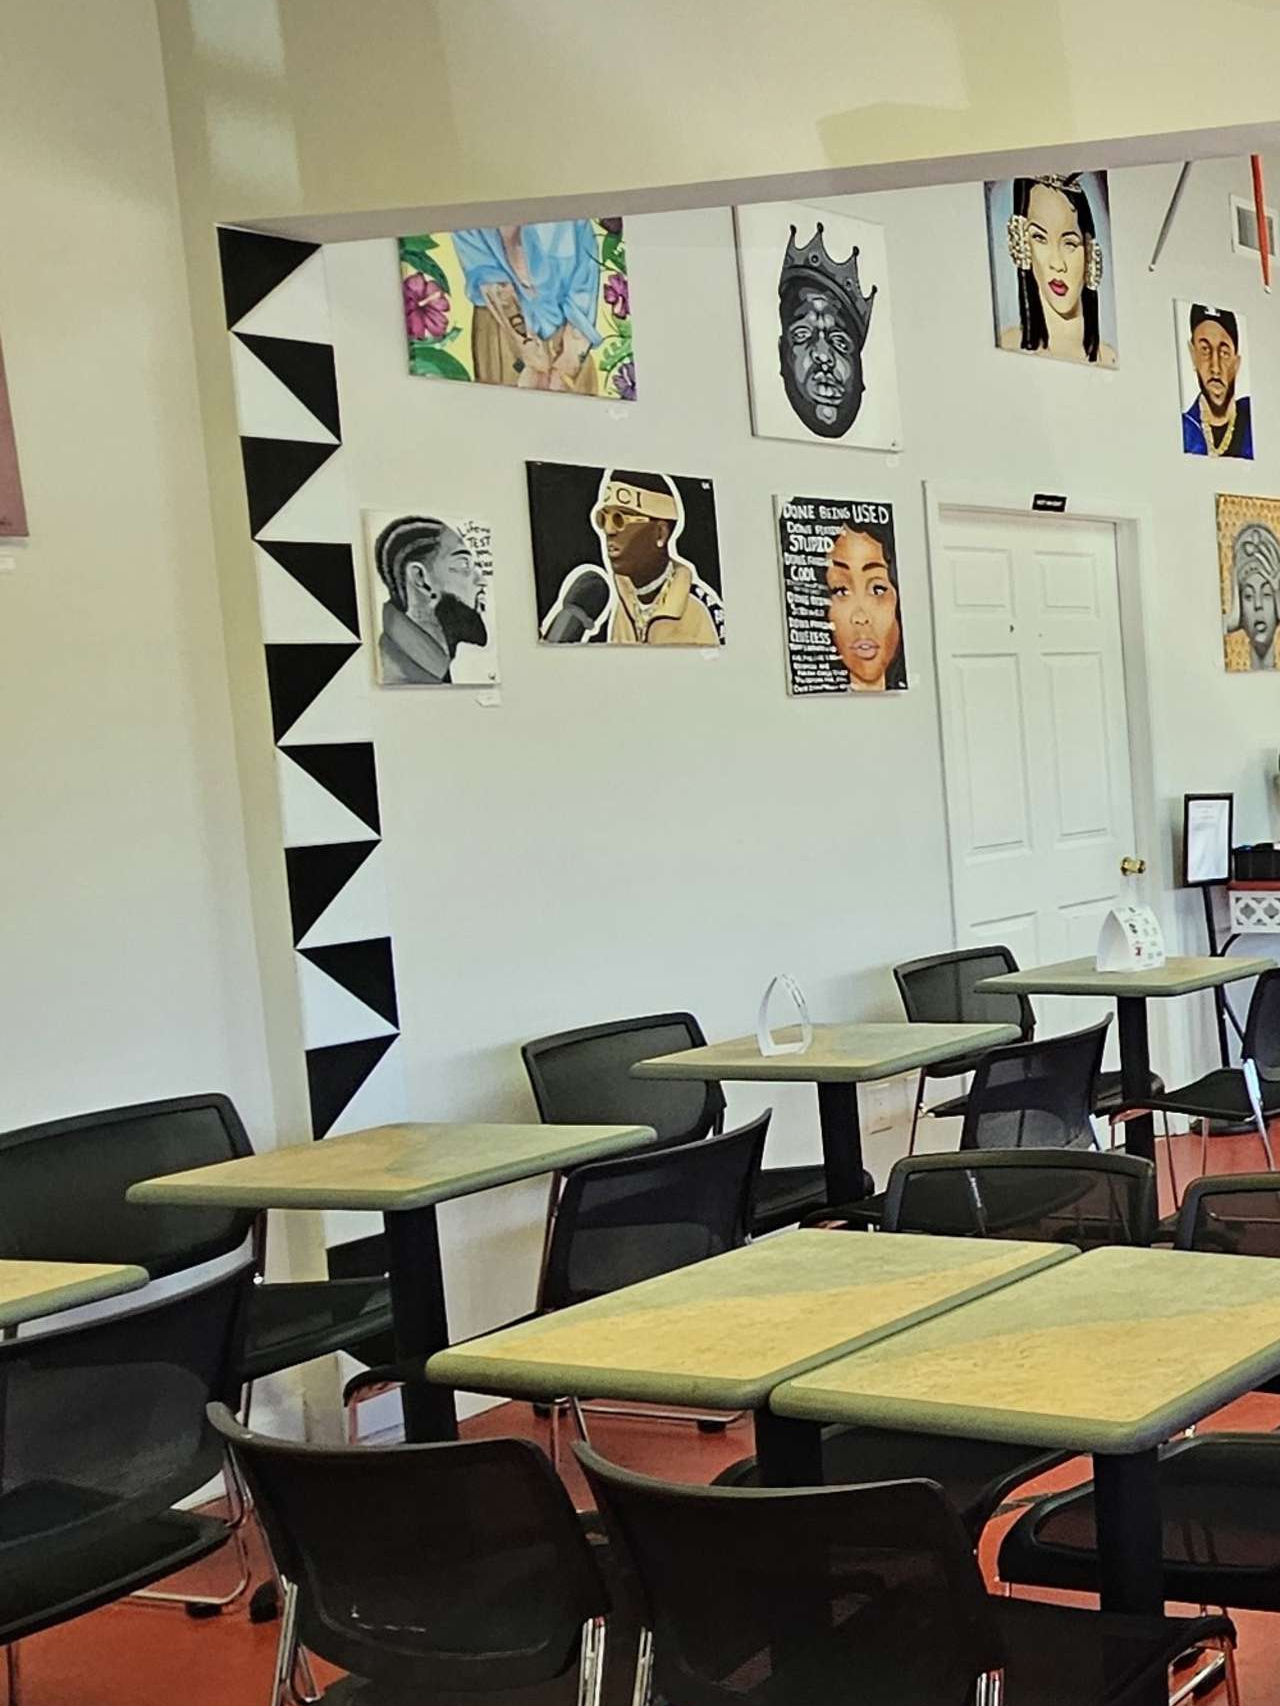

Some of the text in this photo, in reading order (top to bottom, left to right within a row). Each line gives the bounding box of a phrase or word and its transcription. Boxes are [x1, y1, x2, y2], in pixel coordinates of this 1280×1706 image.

[783, 502, 816, 519] DONE
[852, 504, 889, 524] USED
[789, 534, 834, 553] STUPID
[790, 565, 817, 582] COOL
